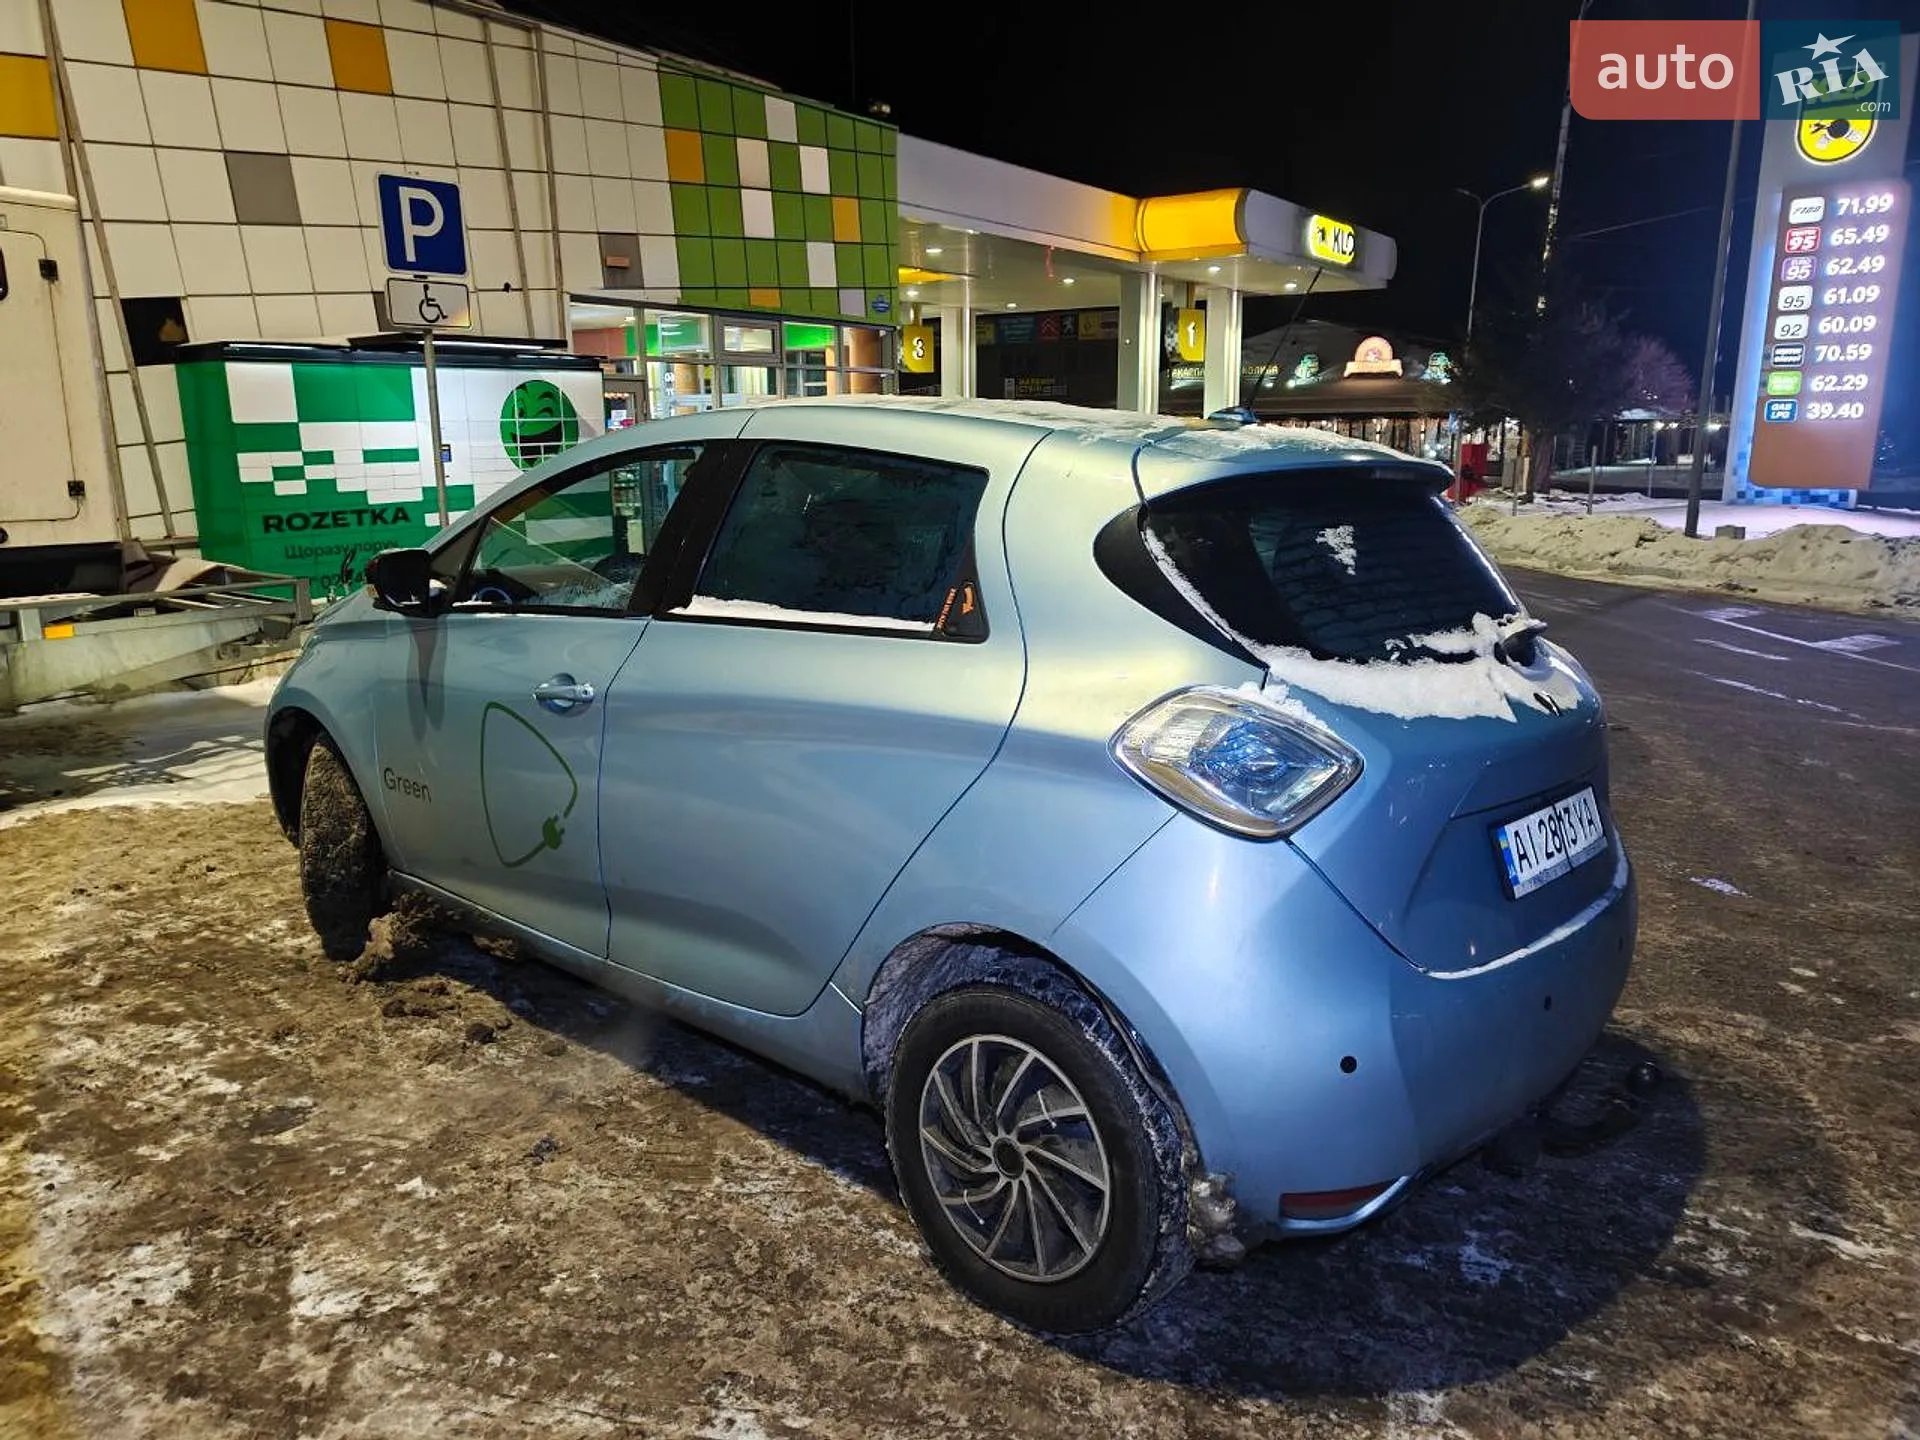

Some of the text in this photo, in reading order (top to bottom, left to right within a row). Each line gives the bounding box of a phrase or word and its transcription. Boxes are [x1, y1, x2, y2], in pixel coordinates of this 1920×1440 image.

[1837, 193, 1894, 216] 71.99
[399, 186, 444, 263] P
[1332, 225, 1356, 256] KLO
[1788, 236, 1816, 251] 95
[1831, 224, 1889, 246] 65.49
[1786, 264, 1812, 281] 95
[1826, 255, 1885, 276] 62.49
[1783, 285, 1880, 309] 95 61.09
[1780, 315, 1876, 338] 92 60.09
[912, 337, 926, 360] 3
[1815, 343, 1872, 363] 70.59
[1810, 374, 1868, 392] 62.29
[1806, 402, 1864, 420] 39.40
[262, 507, 411, 534] ROZETKA
[383, 767, 432, 803] Green
[1514, 825, 1539, 873] AI
[1572, 798, 1598, 840] YA
